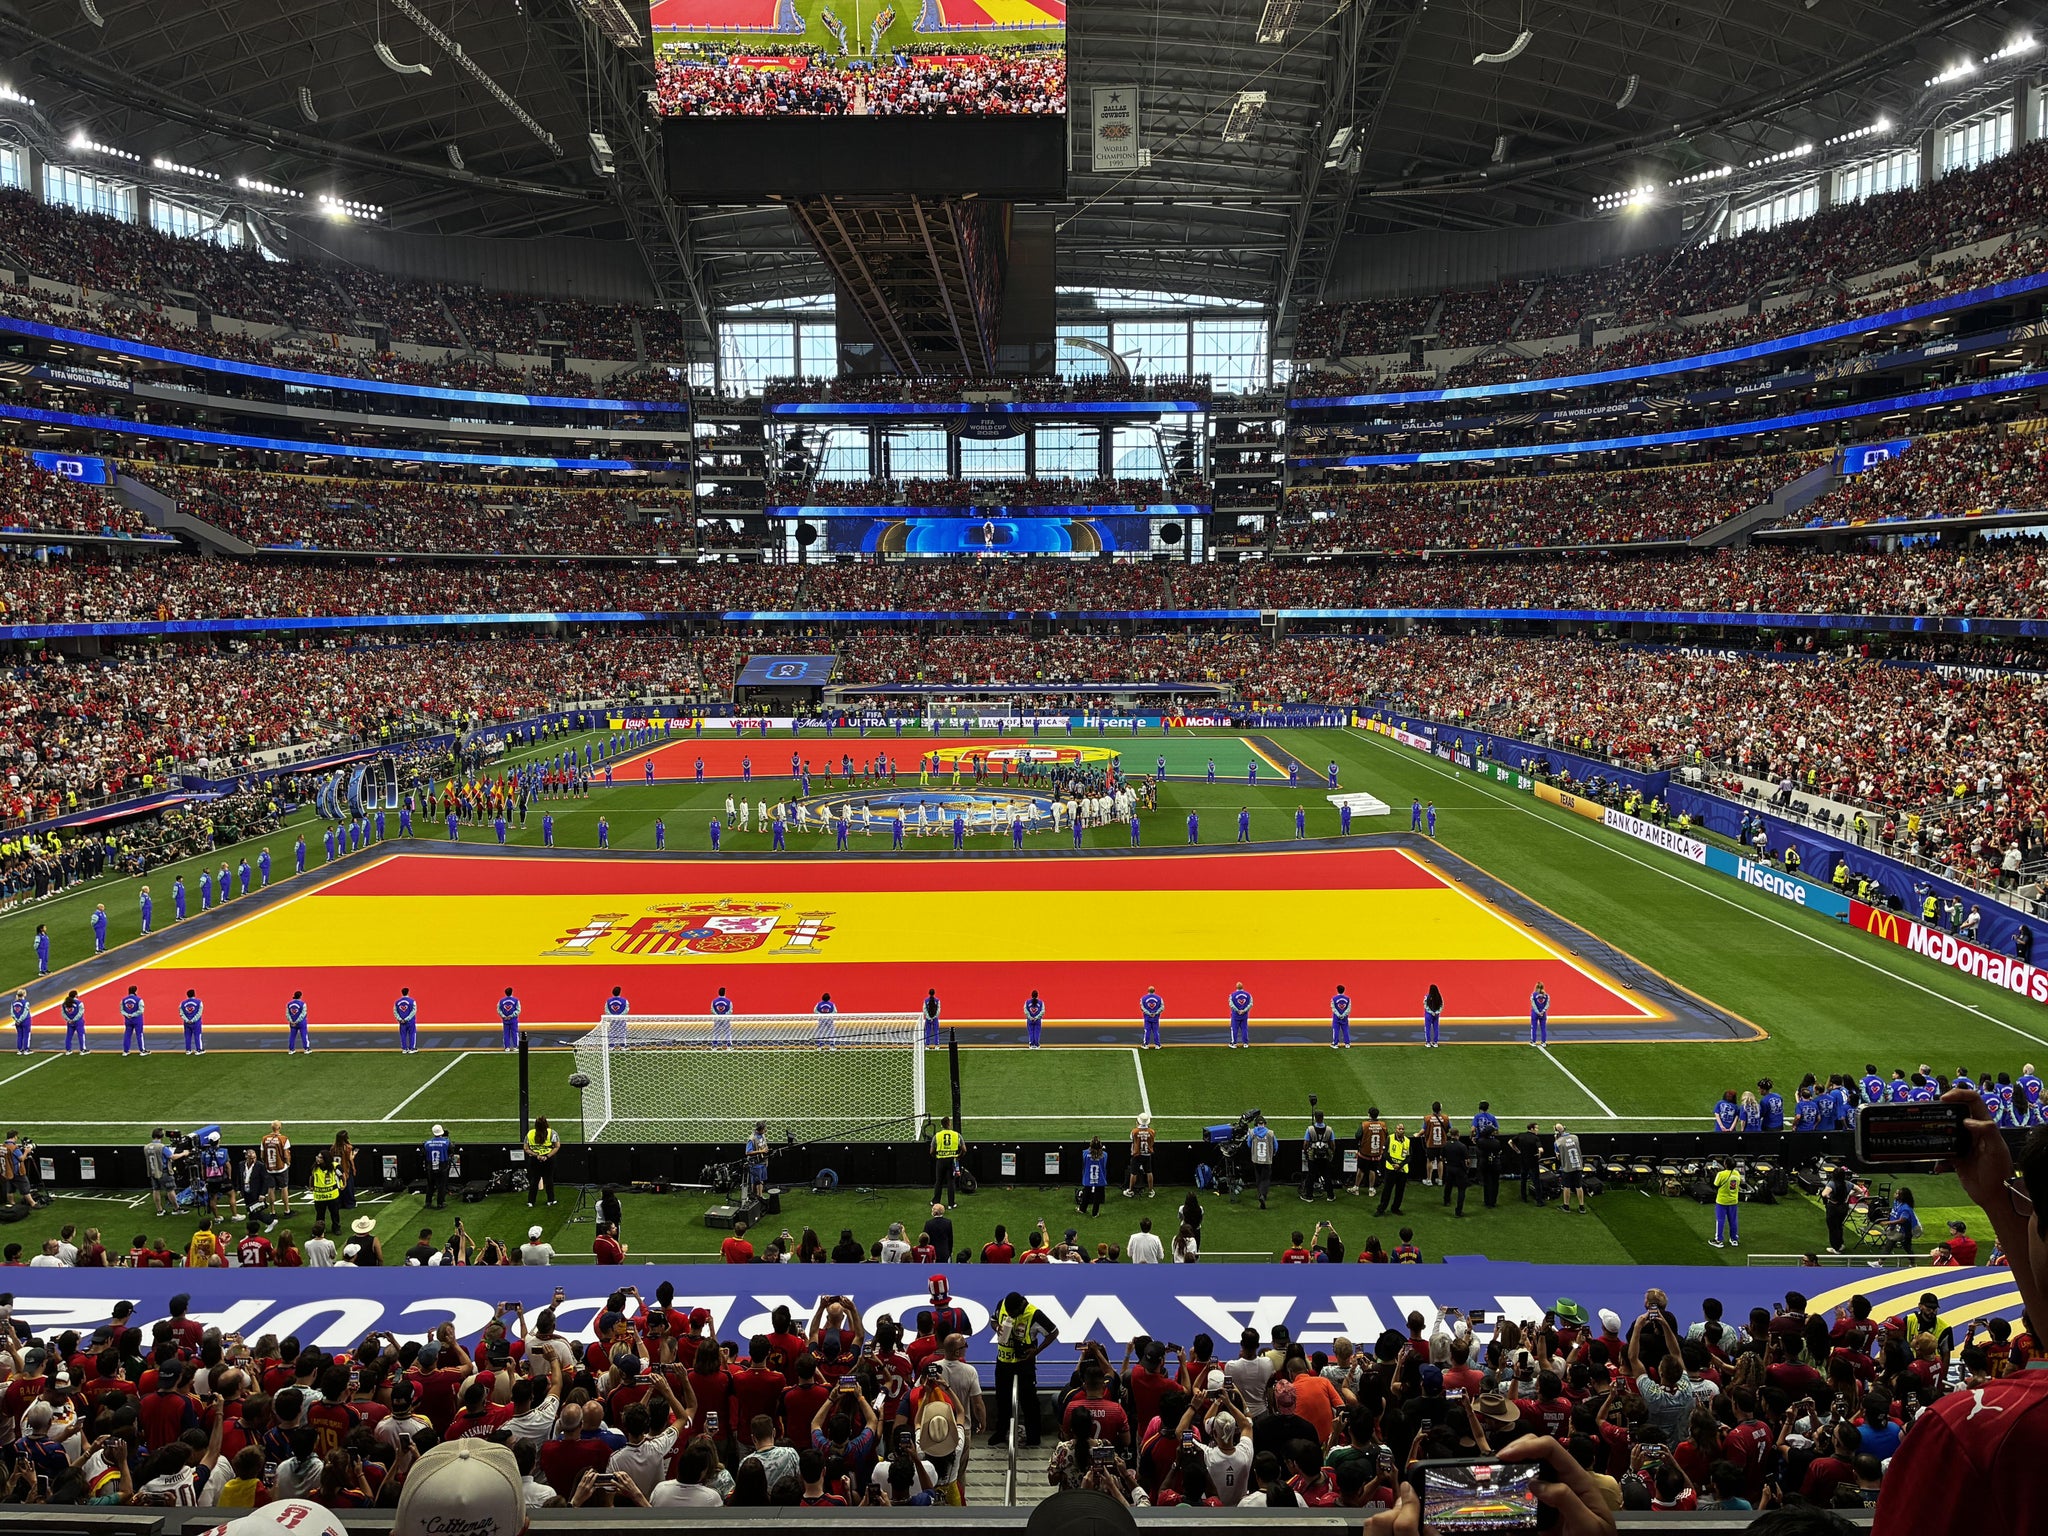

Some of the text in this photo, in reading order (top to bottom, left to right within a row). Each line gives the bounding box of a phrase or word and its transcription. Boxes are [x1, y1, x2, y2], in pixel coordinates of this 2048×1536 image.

[1104, 127, 1126, 138] XXX
[51, 369, 130, 390] FIFA WORLD CUP 2026
[1735, 381, 1772, 395] DALLAS
[1553, 404, 1629, 418] FIFA WORLD CUP 2026
[1401, 421, 1444, 430] DALLAS
[670, 717, 691, 729] Lay's
[848, 718, 887, 727] ULTRA
[1454, 751, 1471, 769] ULTRA
[1560, 793, 1575, 809] TEXAS
[1607, 809, 1690, 856] BANK OF AMERICA
[1737, 857, 1806, 905] Hisense
[1907, 921, 2048, 1004] McDonald's
[132, 1256, 139, 1267] 7
[243, 1248, 260, 1264] 21
[890, 1249, 897, 1262] 7
[921, 1254, 927, 1263] 7
[140, 1298, 496, 1347] CUP
[511, 1295, 1153, 1344] WORLD
[1174, 1296, 1562, 1344] FIFA
[1932, 1374, 1940, 1388] 7
[1543, 1412, 1565, 1421] RONALDO
[1547, 1422, 1560, 1436] 7
